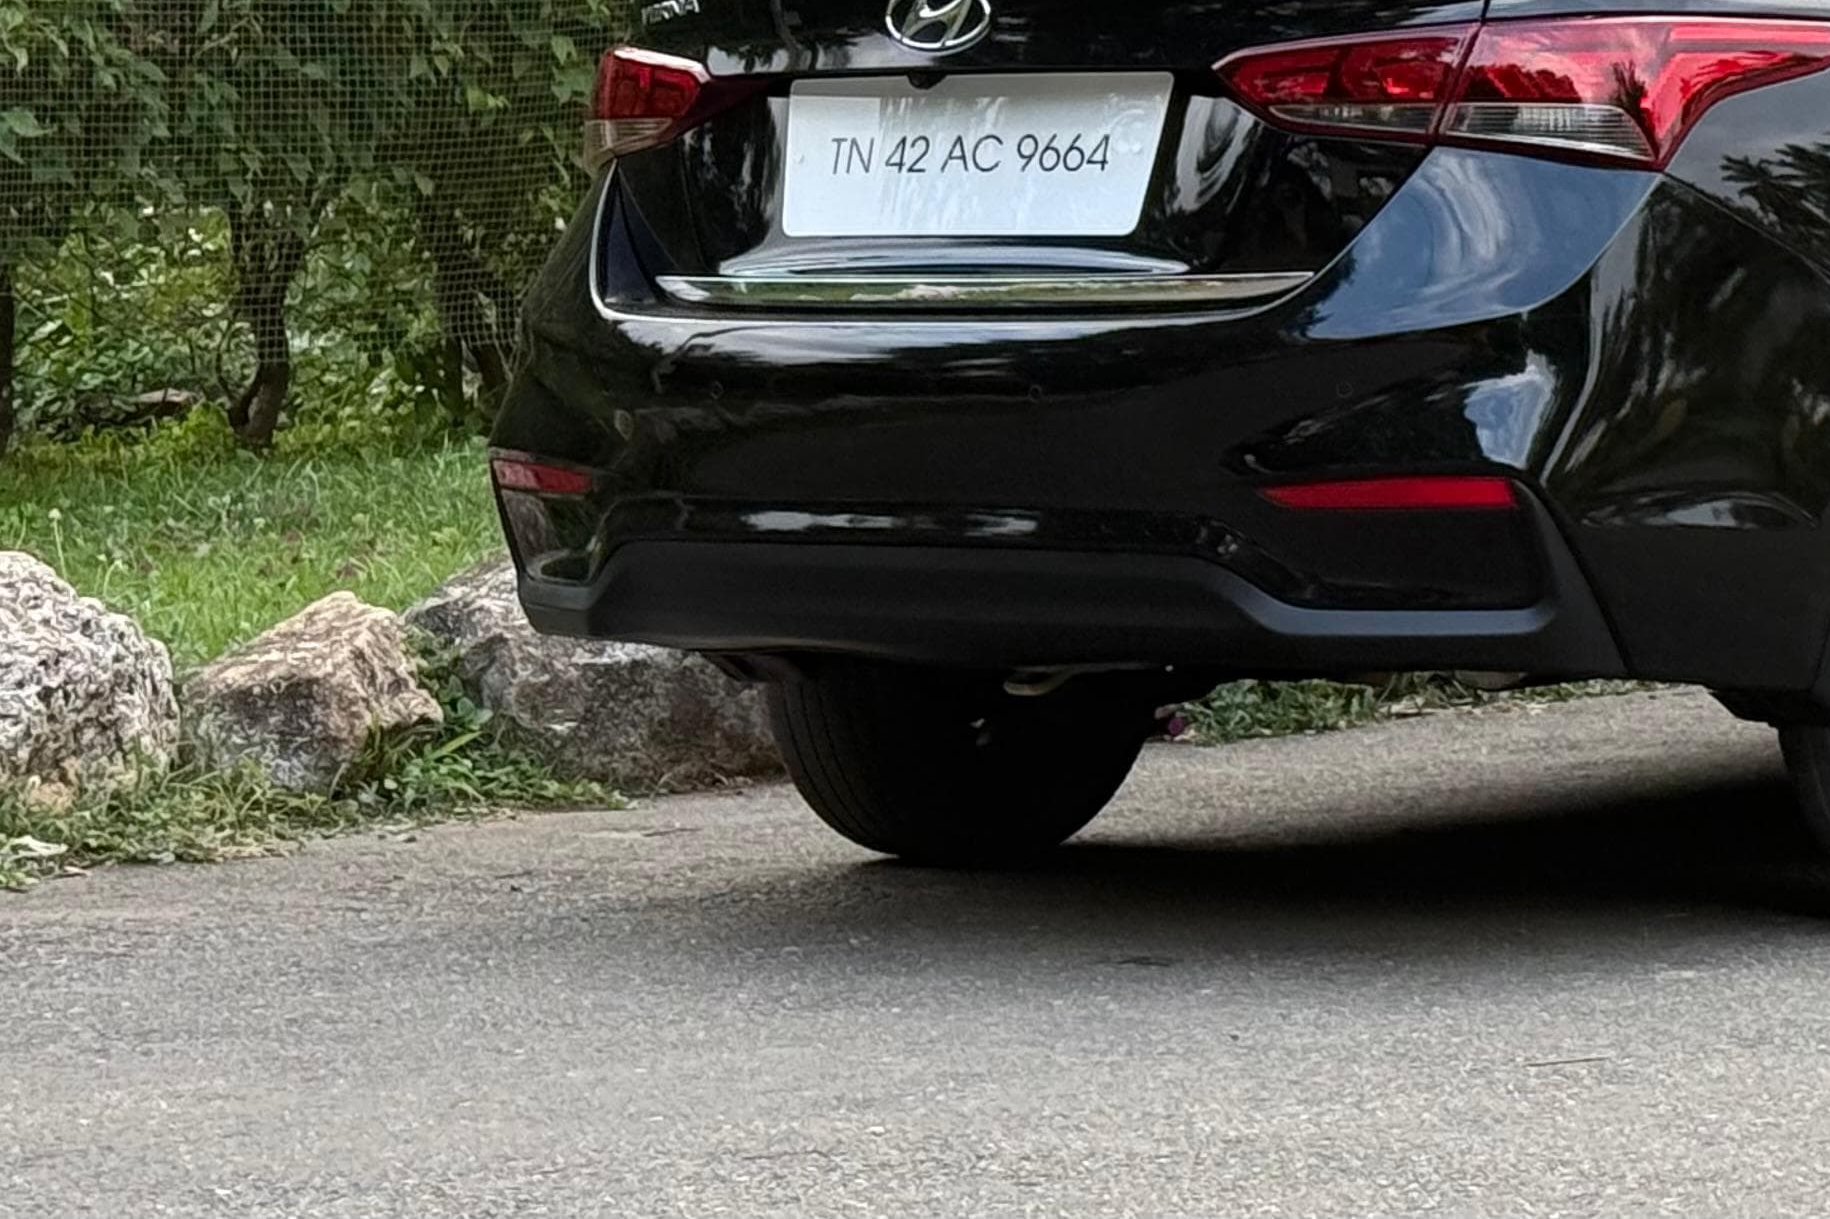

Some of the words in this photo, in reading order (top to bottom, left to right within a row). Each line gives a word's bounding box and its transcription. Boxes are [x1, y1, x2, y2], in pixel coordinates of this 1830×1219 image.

[831, 136, 874, 175] TN
[884, 135, 927, 174] 42
[940, 134, 1003, 172] AC
[1016, 133, 1111, 172] 9664
